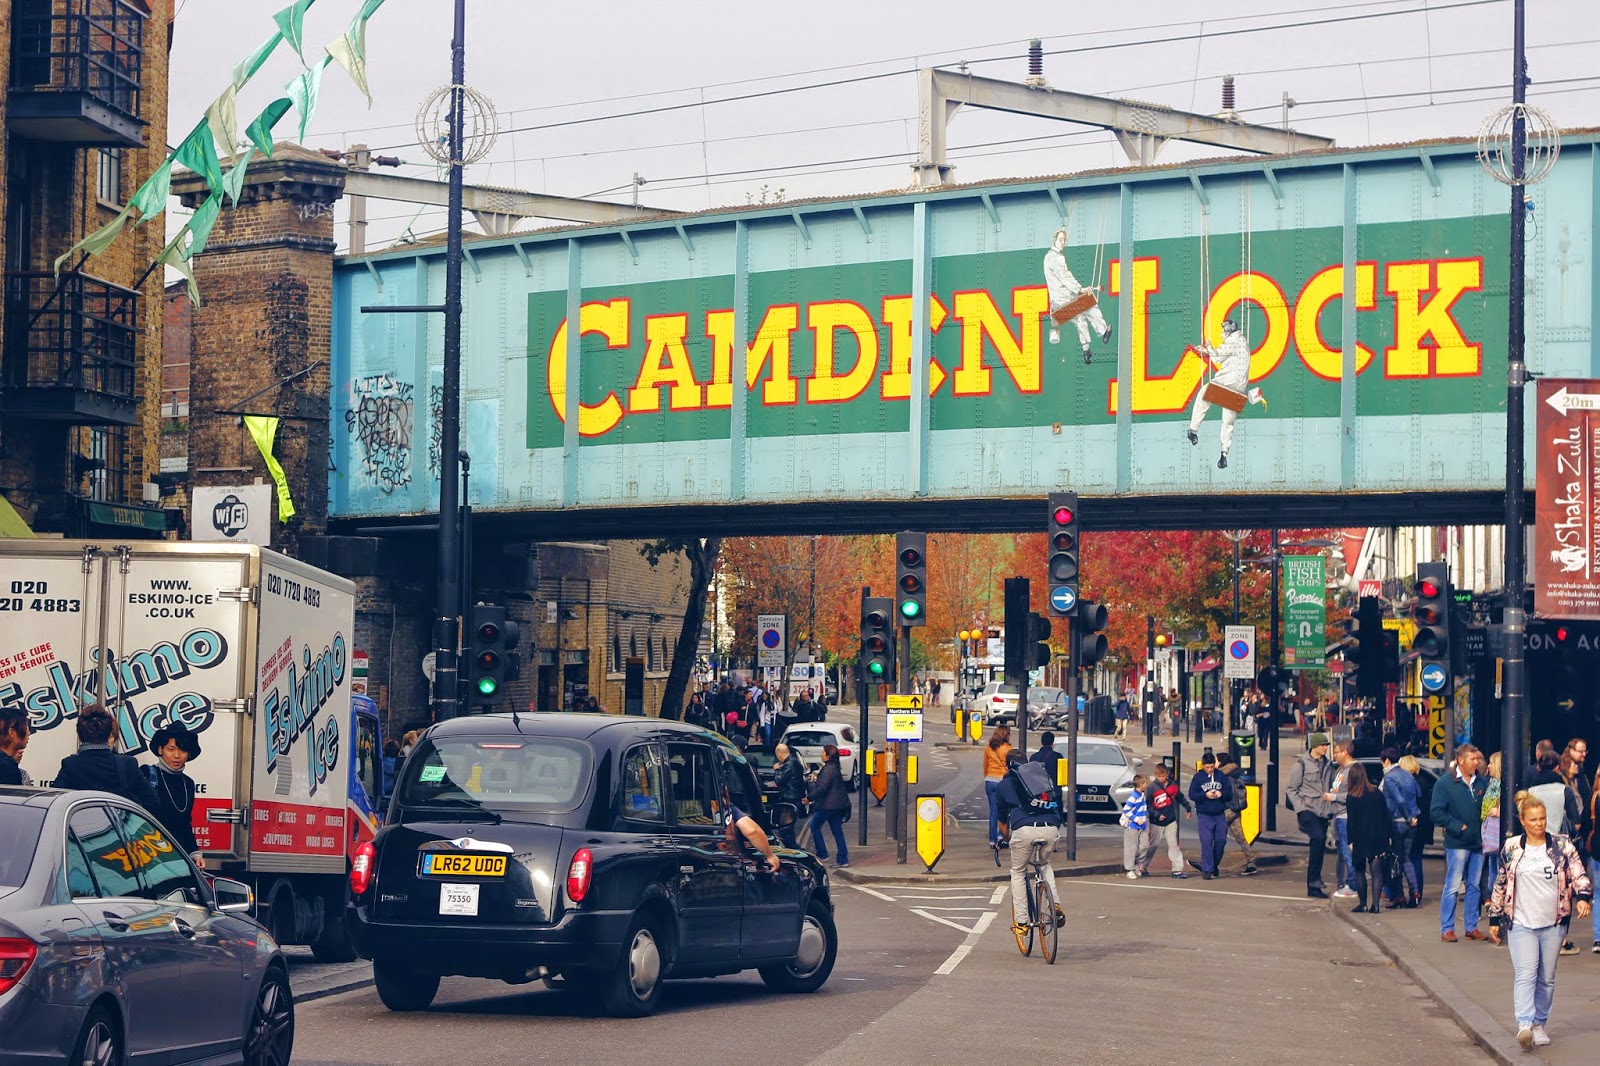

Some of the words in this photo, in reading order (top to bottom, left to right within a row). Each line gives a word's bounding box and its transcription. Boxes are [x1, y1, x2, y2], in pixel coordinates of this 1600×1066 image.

[546, 286, 1049, 436] CAMDEN
[1108, 256, 1483, 415] LOCK
[1562, 396, 1594, 408] 20m
[1552, 425, 1581, 476] Zulu
[112, 507, 130, 524] THE
[1553, 481, 1584, 542] Shaka
[1288, 568, 1320, 580] FISH
[11, 581, 48, 594] 020
[150, 580, 192, 590] WWW.
[267, 573, 281, 595] 020
[284, 579, 300, 602] 7720
[303, 586, 320, 608] 4883
[30, 599, 80, 612] 4883
[128, 593, 213, 605] ESKIMO-ICE
[145, 608, 195, 618] .CO.UK
[13, 651, 27, 663] ICE
[29, 642, 52, 656] CUBE
[20, 652, 55, 671] SERVICE
[263, 631, 346, 775] Eskimo
[105, 691, 215, 756] Ice
[306, 714, 340, 798] Ice
[434, 857, 471, 872] LR62
[447, 894, 471, 903] 75350
